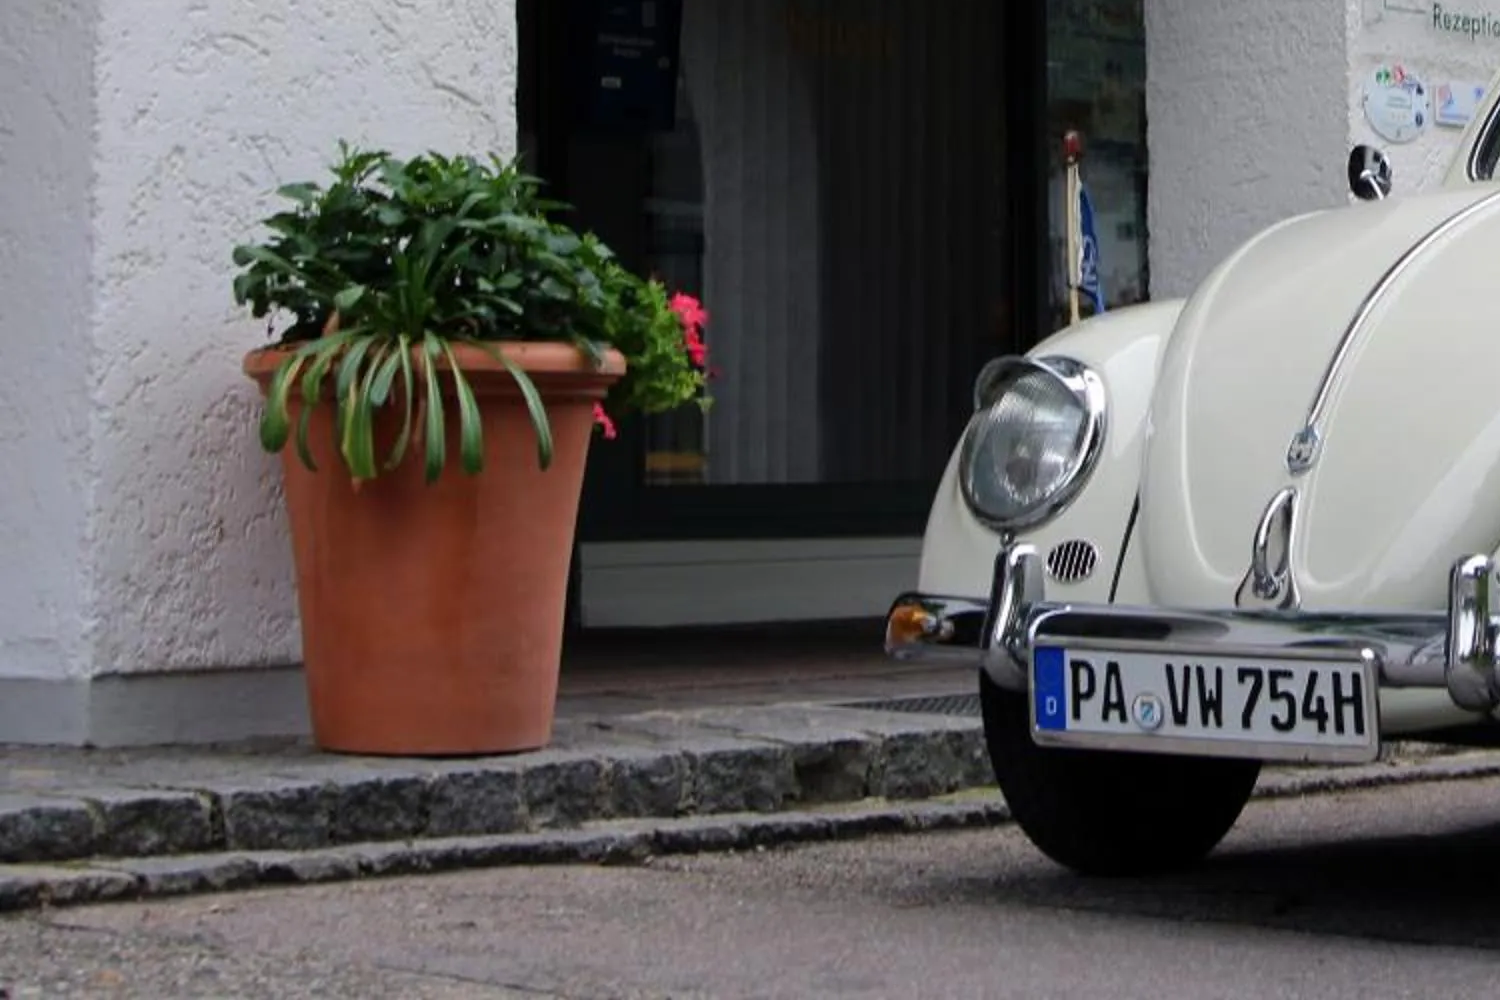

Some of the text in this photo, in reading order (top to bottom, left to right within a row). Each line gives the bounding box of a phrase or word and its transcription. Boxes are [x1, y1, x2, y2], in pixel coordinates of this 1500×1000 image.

[1044, 696, 1058, 716] D
[1069, 659, 1366, 736] PA VW 754H
